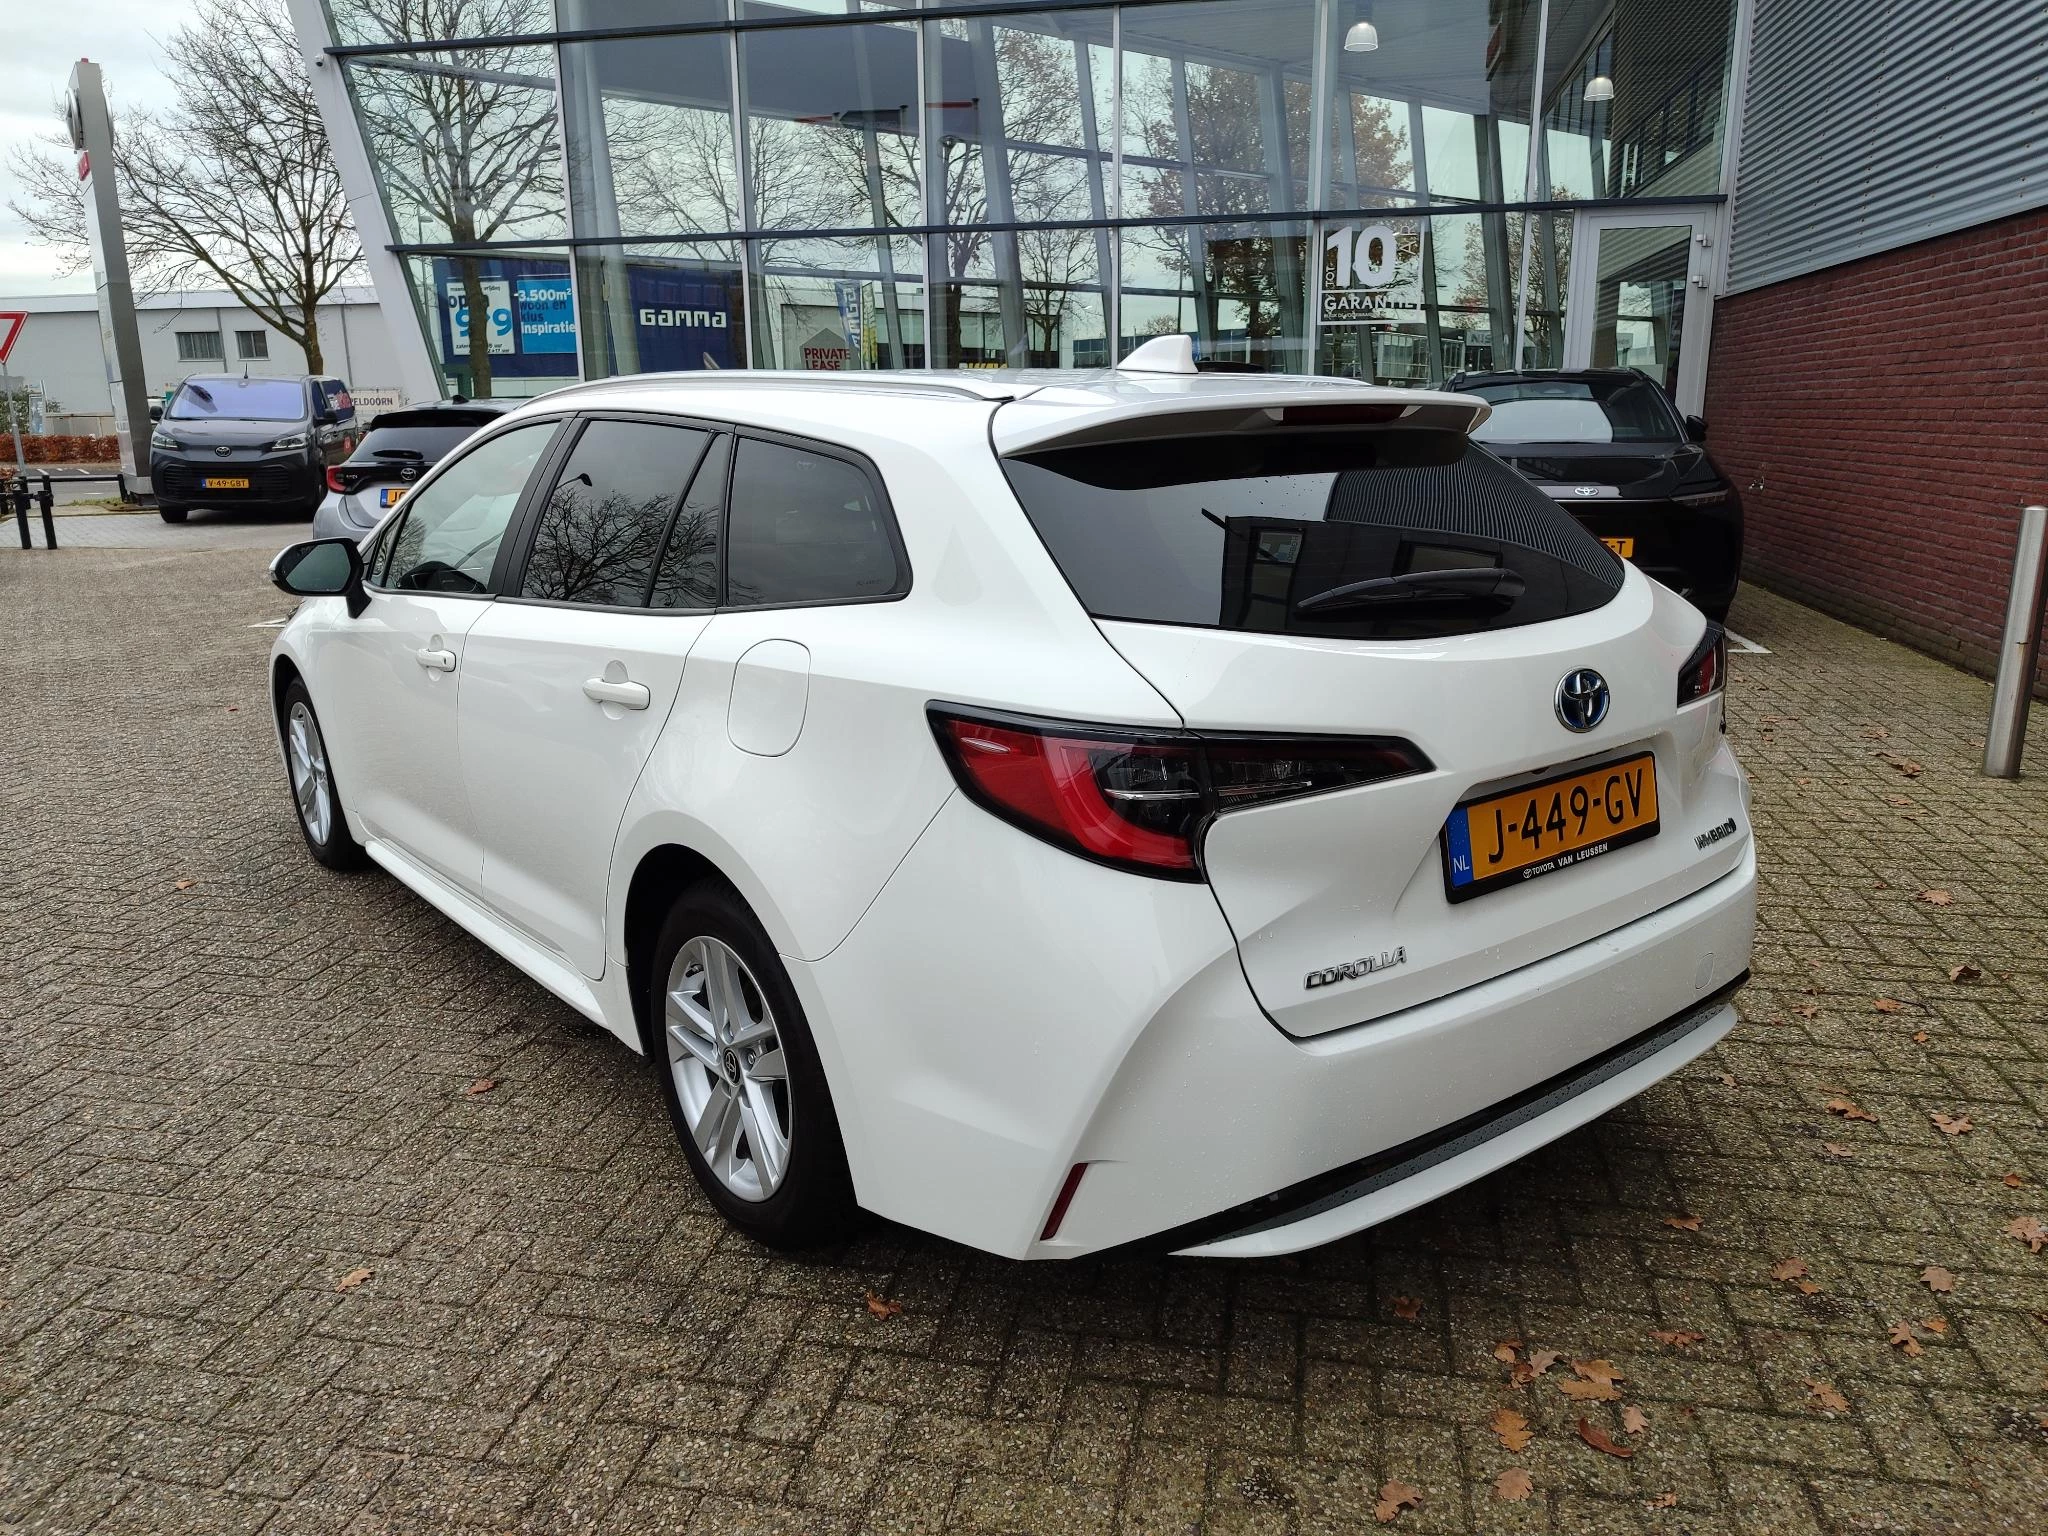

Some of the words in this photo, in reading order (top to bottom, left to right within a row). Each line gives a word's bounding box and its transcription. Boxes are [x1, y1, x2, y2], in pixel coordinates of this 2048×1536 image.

[1327, 225, 1397, 288] 10
[1326, 265, 1337, 289] TOT
[520, 301, 549, 310] woon
[553, 300, 567, 310] en
[520, 311, 545, 322] klus
[521, 321, 576, 336] inspiratie
[804, 347, 851, 360] PRIVATE
[806, 360, 841, 370] LEASE
[208, 479, 247, 487] V-49-GBT
[1488, 768, 1642, 864] J-449-GV
[1453, 855, 1471, 874] NL
[1531, 861, 1555, 875] TOYOTA
[1557, 854, 1573, 867] VAN
[1576, 842, 1608, 861] LEUSSEN
[1304, 946, 1407, 989] COROLLA
